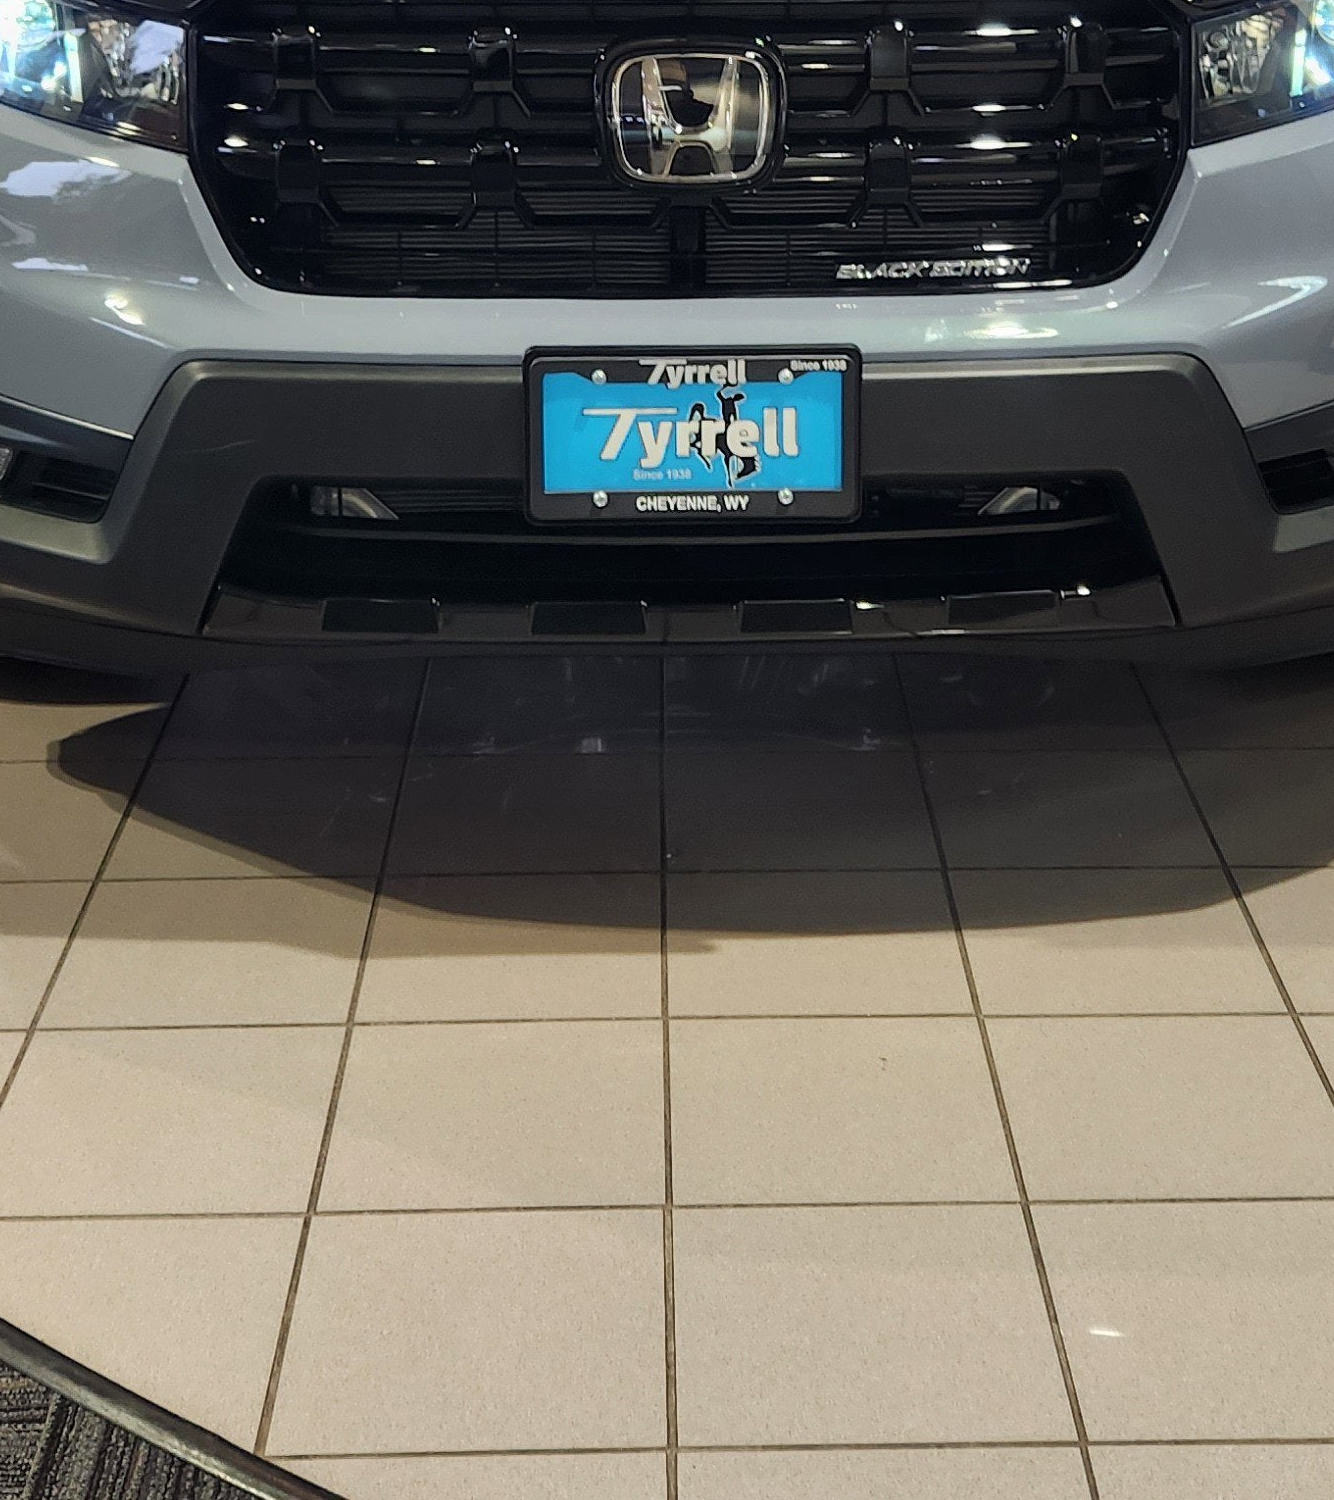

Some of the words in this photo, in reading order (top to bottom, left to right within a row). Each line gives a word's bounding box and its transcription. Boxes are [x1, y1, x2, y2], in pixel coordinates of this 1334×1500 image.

[638, 358, 746, 389] Tyrrell
[790, 359, 820, 371] Since
[582, 406, 800, 469] Tyrrell
[636, 495, 721, 512] CHEYENNE,
[723, 495, 749, 510] WY
